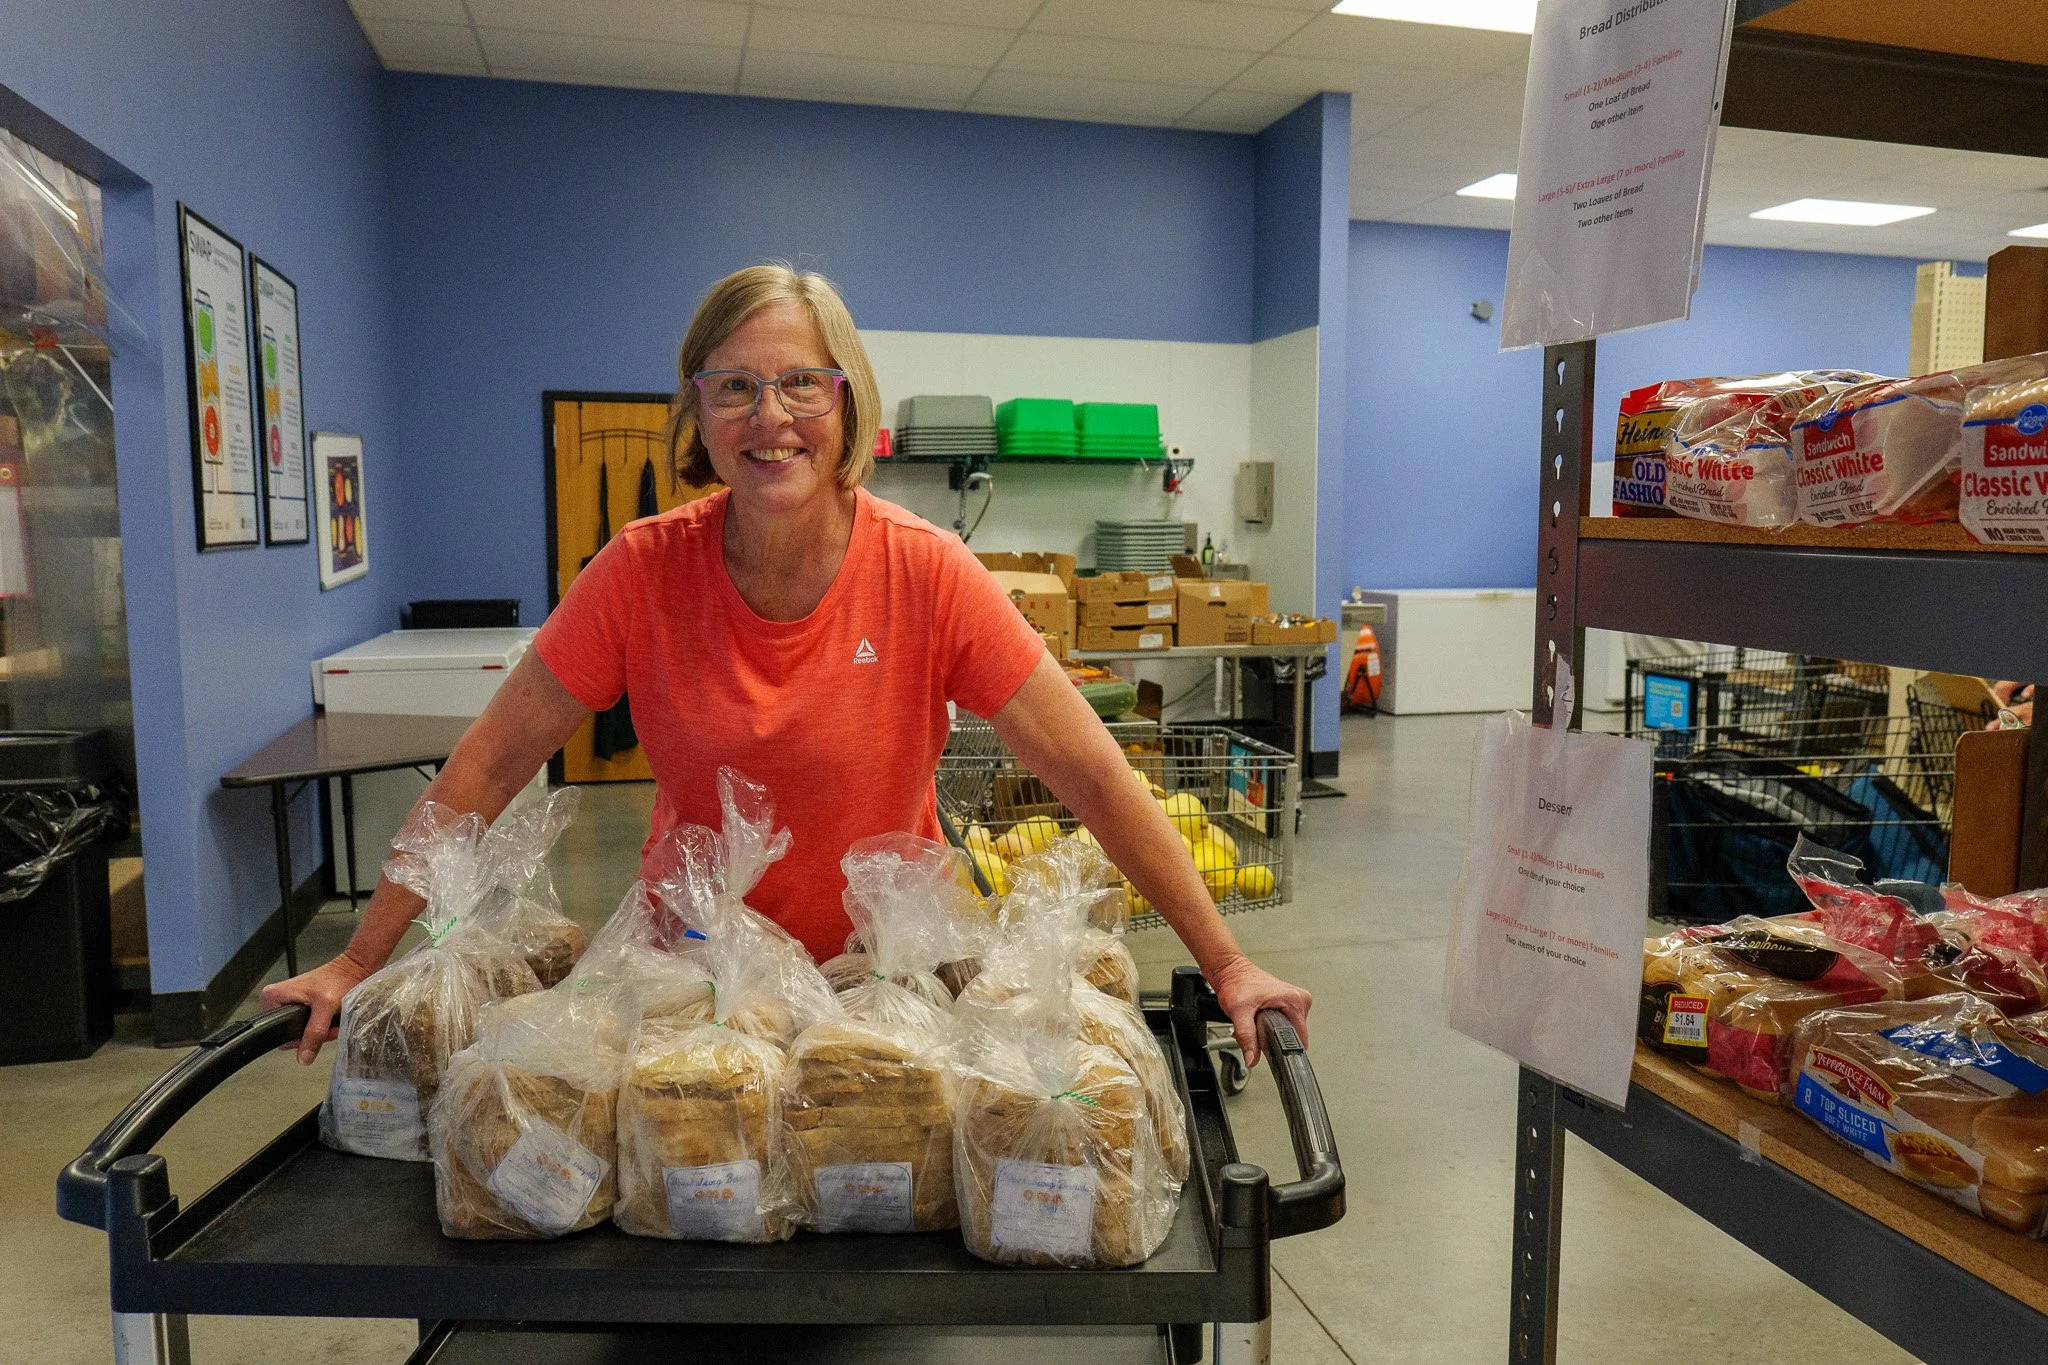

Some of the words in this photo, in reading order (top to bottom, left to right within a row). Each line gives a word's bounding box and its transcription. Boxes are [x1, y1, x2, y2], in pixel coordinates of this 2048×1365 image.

[1580, 15, 1613, 40] Bread
[1615, 0, 1668, 25] Distribu
[1564, 87, 1583, 102] Small
[1634, 59, 1651, 76] (3-4)
[1652, 48, 1683, 67] Families
[1588, 102, 1603, 112] One
[1605, 92, 1621, 106] Loaf
[1621, 88, 1630, 100] of
[1630, 79, 1651, 96] Bread
[1607, 110, 1627, 123] other
[1628, 104, 1644, 117] item
[1538, 189, 1556, 203] Large
[1577, 179, 1595, 192] Extra
[1596, 173, 1615, 187] Large
[1616, 169, 1624, 181] (7
[1625, 168, 1632, 177] or
[1633, 158, 1656, 174] more)
[1657, 149, 1686, 166] Families
[1573, 202, 1588, 211] Two
[1589, 193, 1613, 207] Loaves
[1614, 189, 1622, 200] of
[1622, 182, 1644, 197] Bread
[1577, 219, 1593, 229] Two
[1593, 212, 1613, 225] other
[1614, 207, 1634, 219] items
[1807, 432, 1851, 455] Sandwich
[1635, 461, 1666, 483] OLD
[1698, 458, 1754, 481] White
[1797, 461, 1834, 488] Classic
[1832, 452, 1884, 479] White
[1697, 483, 1724, 497] Bread
[1840, 479, 1865, 495] Bread
[1964, 469, 2032, 497] Classic
[1986, 499, 2040, 516] Enriched
[1983, 527, 2004, 541] NO
[853, 656, 878, 665] Reebok
[1538, 797, 1573, 816] Dessert
[1556, 860, 1573, 872] (3-4)
[1574, 865, 1605, 880] Families
[1545, 877, 1561, 887] your
[1562, 881, 1586, 893] choice
[1517, 938, 1536, 952] items
[1537, 946, 1545, 955] of
[1546, 949, 1561, 960] your
[1563, 953, 1587, 968] choice
[1530, 925, 1548, 938] Large
[1549, 931, 1556, 941] (7
[1557, 934, 1566, 942] or
[1567, 937, 1589, 951] more)
[1590, 943, 1619, 960] Families
[1674, 1001, 1704, 1009] REDUCED
[1675, 1013, 1695, 1026] $1.64
[1817, 1053, 1863, 1083] PEPPERIDGE
[1862, 1078, 1885, 1104] FARM
[1804, 1088, 1812, 1104] 8
[1820, 1094, 1836, 1113] TOP
[1838, 1106, 1876, 1134] SLICED
[1824, 1112, 1840, 1129] SOFT
[1842, 1123, 1868, 1142] WHITE
